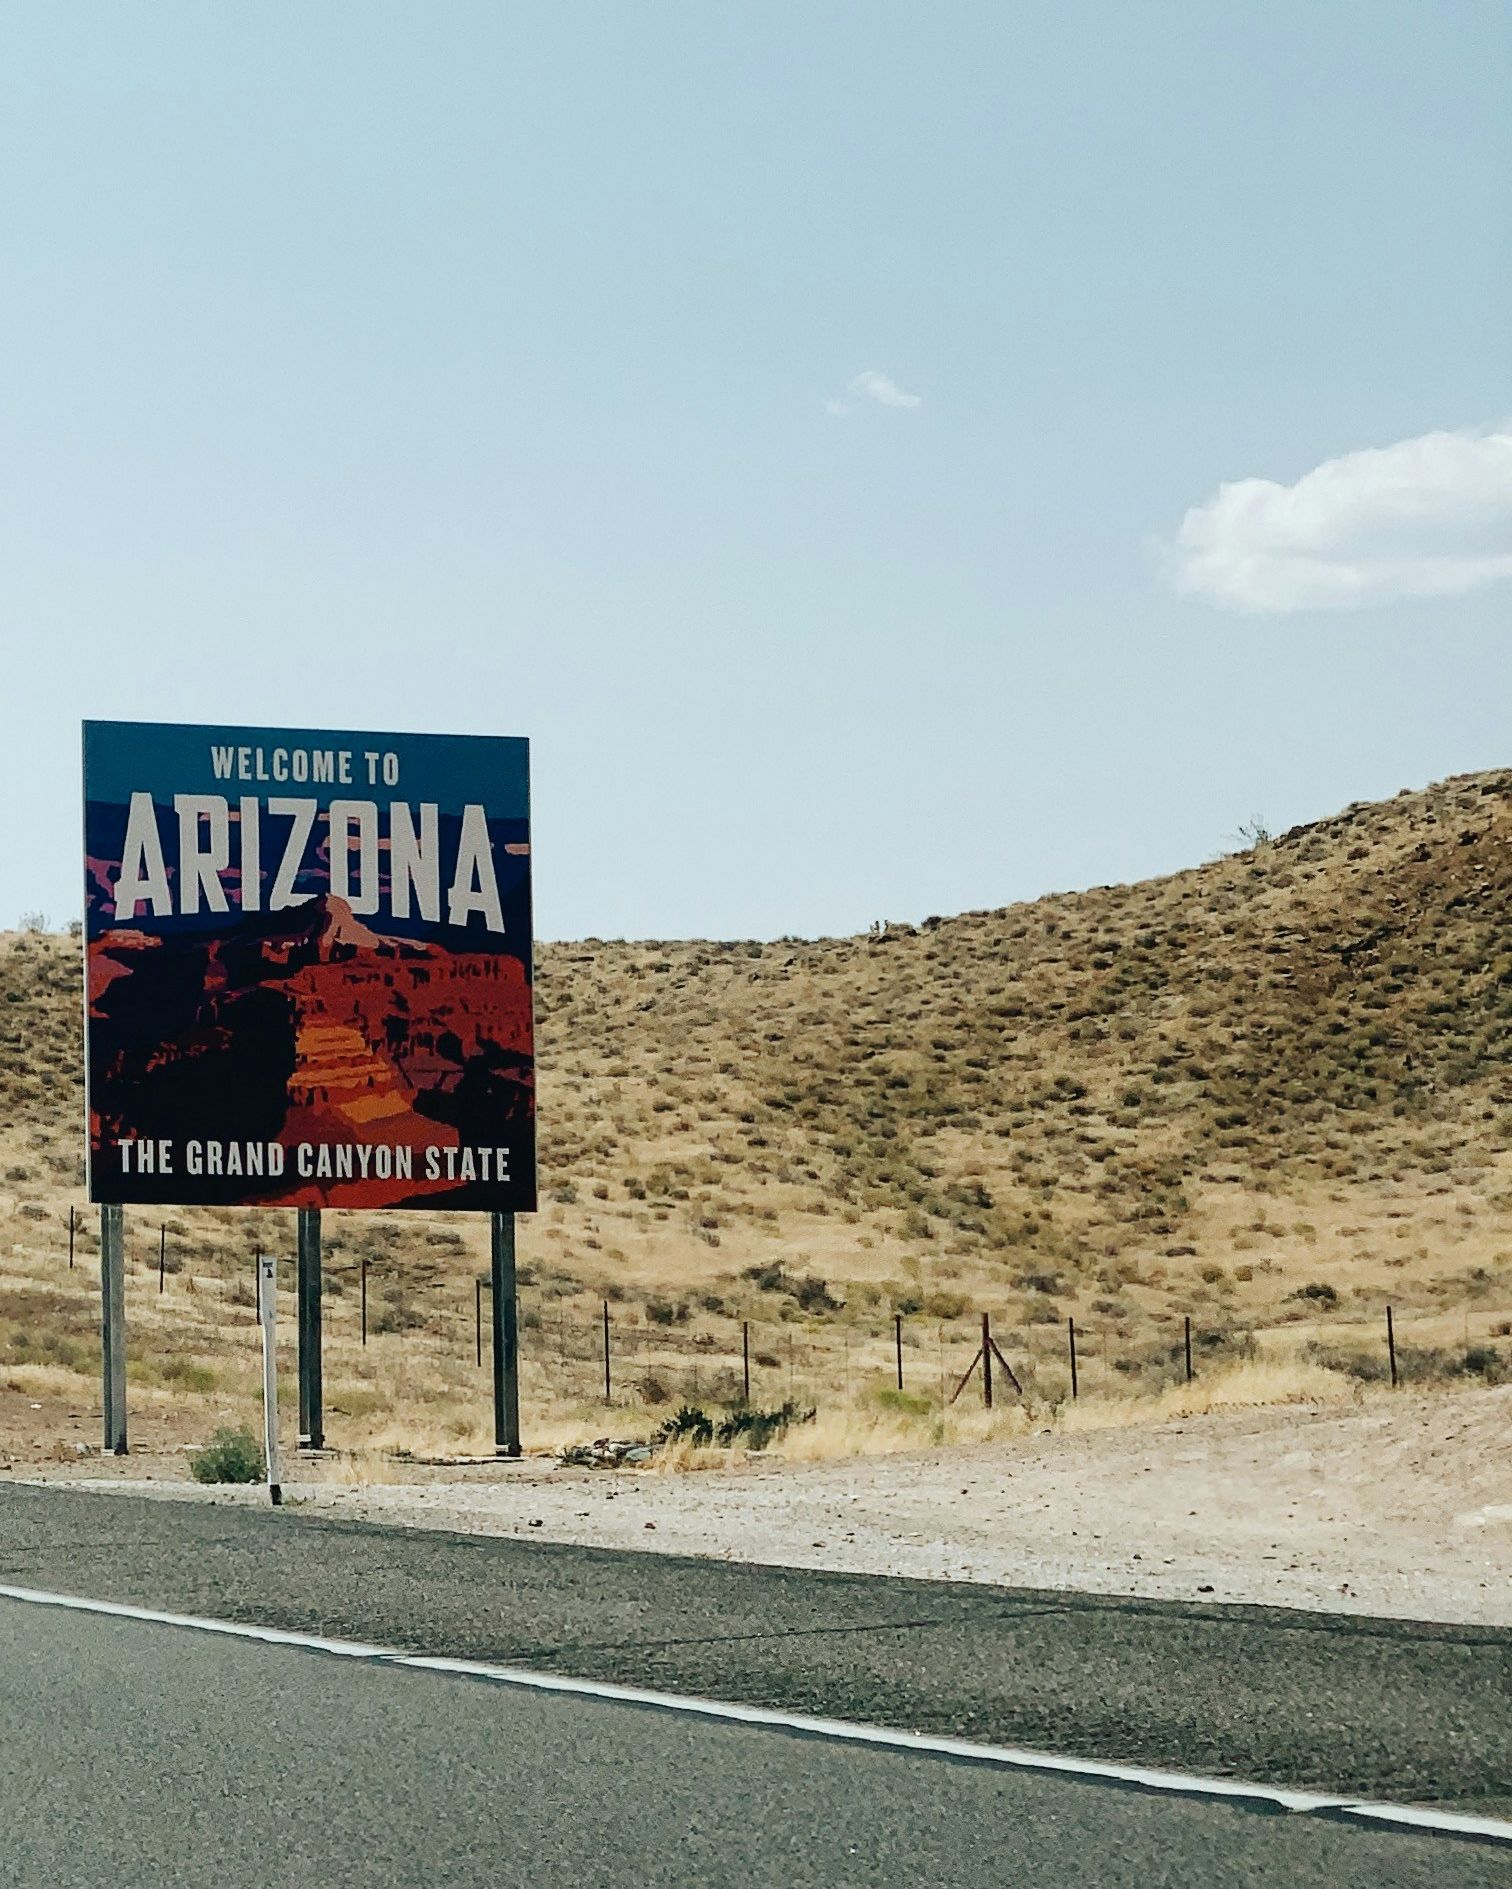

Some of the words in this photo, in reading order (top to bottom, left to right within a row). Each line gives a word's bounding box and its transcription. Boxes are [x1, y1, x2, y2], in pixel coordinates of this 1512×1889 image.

[211, 746, 353, 784] WELCOME
[365, 752, 400, 786] TO
[114, 791, 506, 934] ARIZONA
[117, 1139, 173, 1174] THE
[186, 1140, 284, 1177] GRAND
[297, 1142, 412, 1180] CANYON
[425, 1145, 511, 1182] STATE
